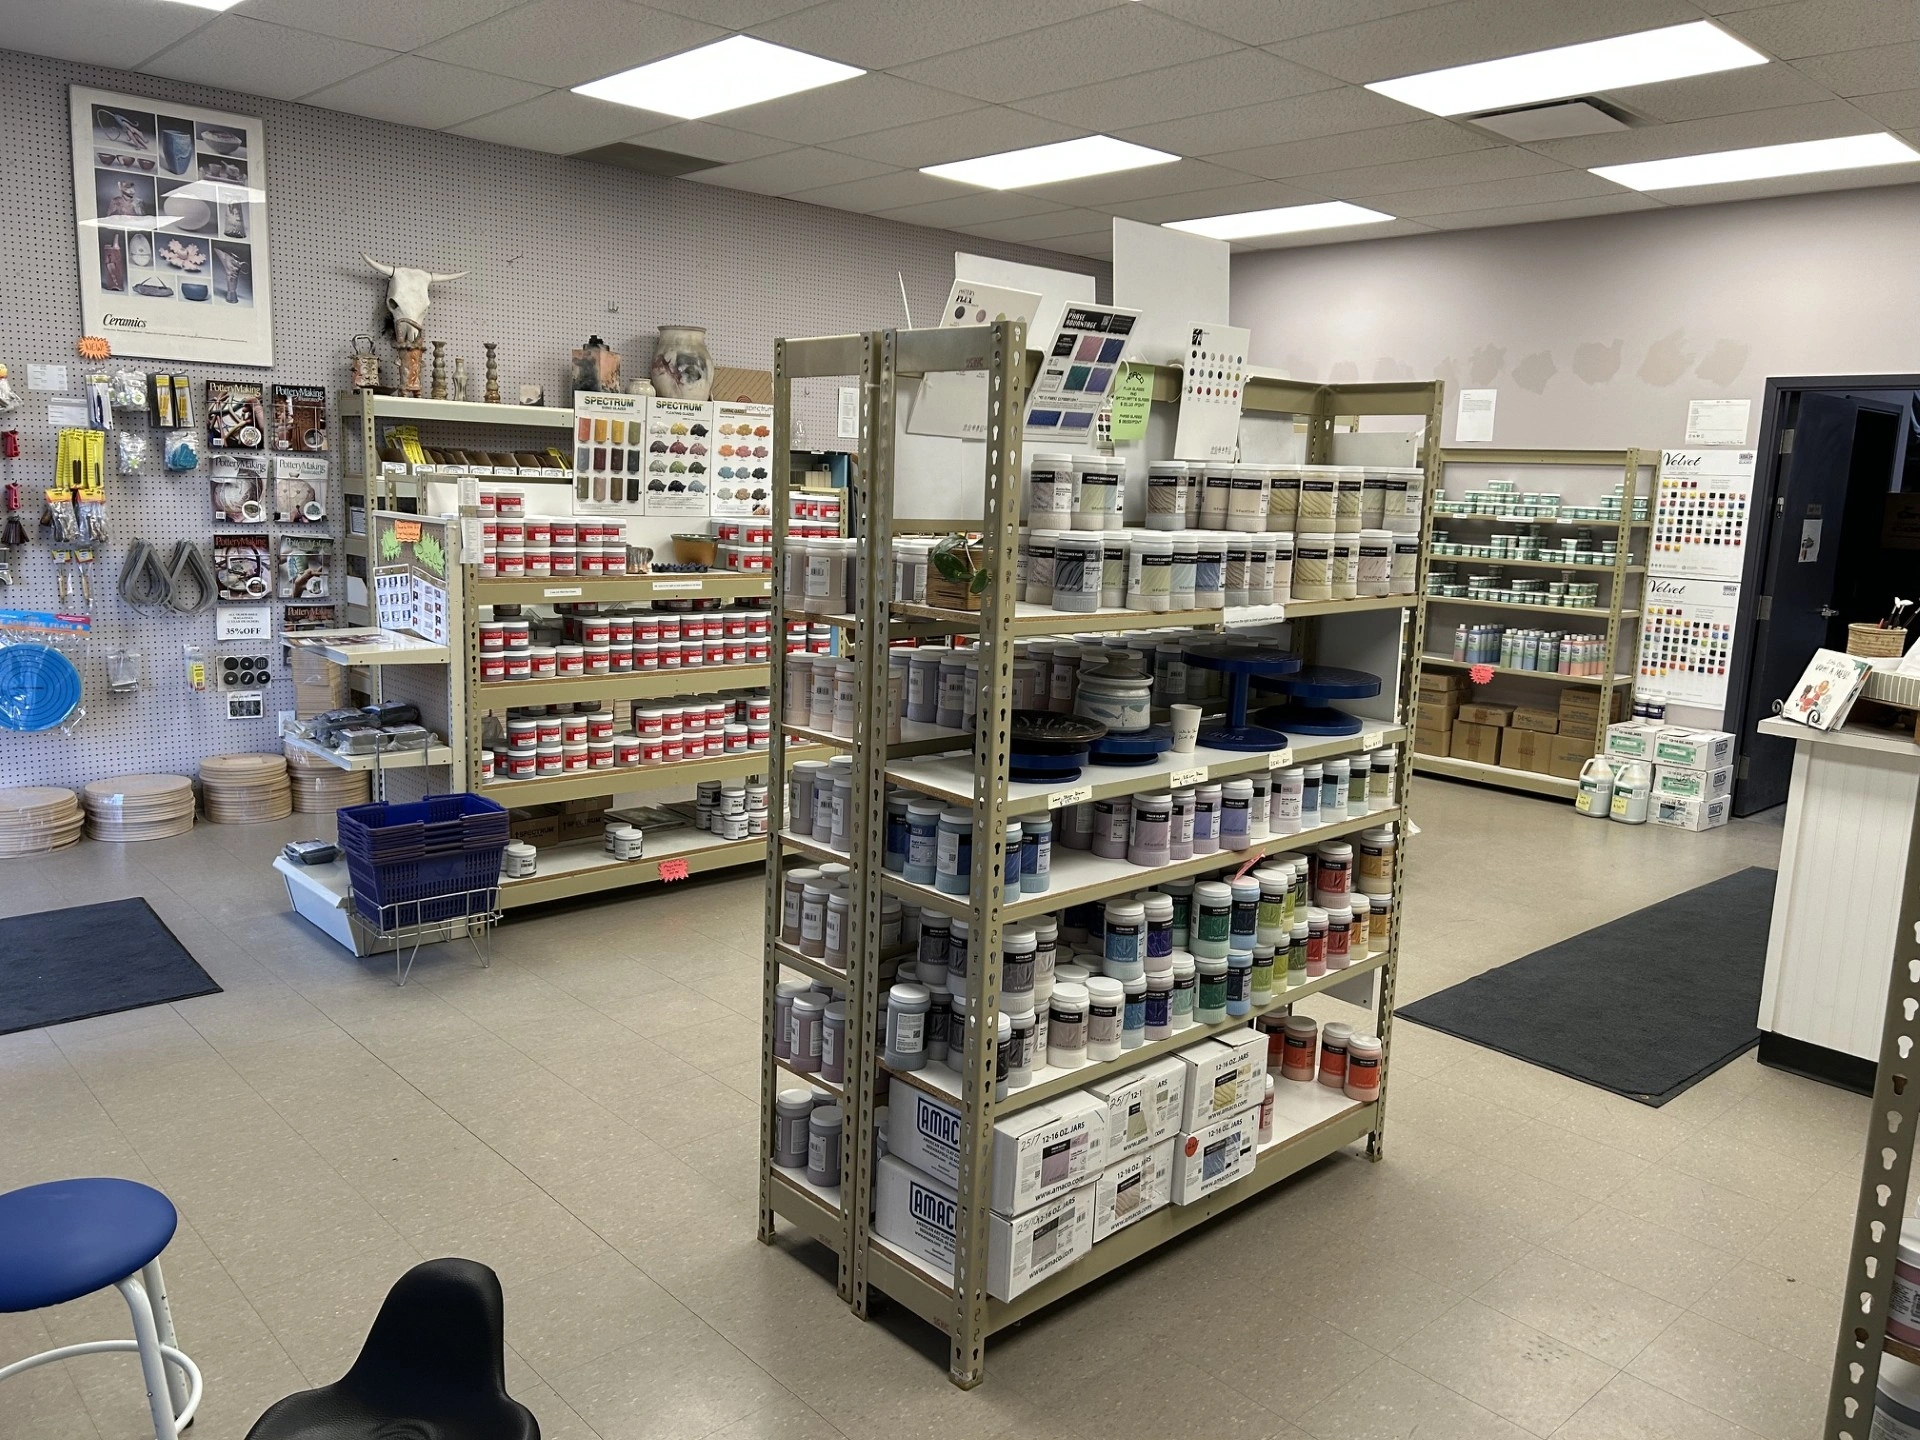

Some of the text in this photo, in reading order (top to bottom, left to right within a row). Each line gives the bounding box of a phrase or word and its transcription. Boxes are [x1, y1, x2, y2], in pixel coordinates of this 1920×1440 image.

[103, 313, 147, 328] Ceramics
[584, 396, 634, 408] SPECTRUM
[656, 400, 702, 412] SPECTRUM
[1663, 452, 1701, 467] Velvet
[1649, 580, 1686, 595] Velvet
[1215, 1060, 1228, 1071] 12-16
[1238, 1052, 1249, 1063] JARS
[1208, 1099, 1247, 1120] www.amaco.com
[922, 1105, 961, 1145] AMAC
[1042, 1131, 1059, 1144] 12-16
[1070, 1121, 1085, 1134] JARS
[1208, 1127, 1221, 1138] 12-16
[1230, 1118, 1243, 1130] JARS
[1035, 1174, 1085, 1201] www.amaco.com
[1201, 1168, 1240, 1192] www.amaco.com
[914, 1189, 957, 1230] AMAC
